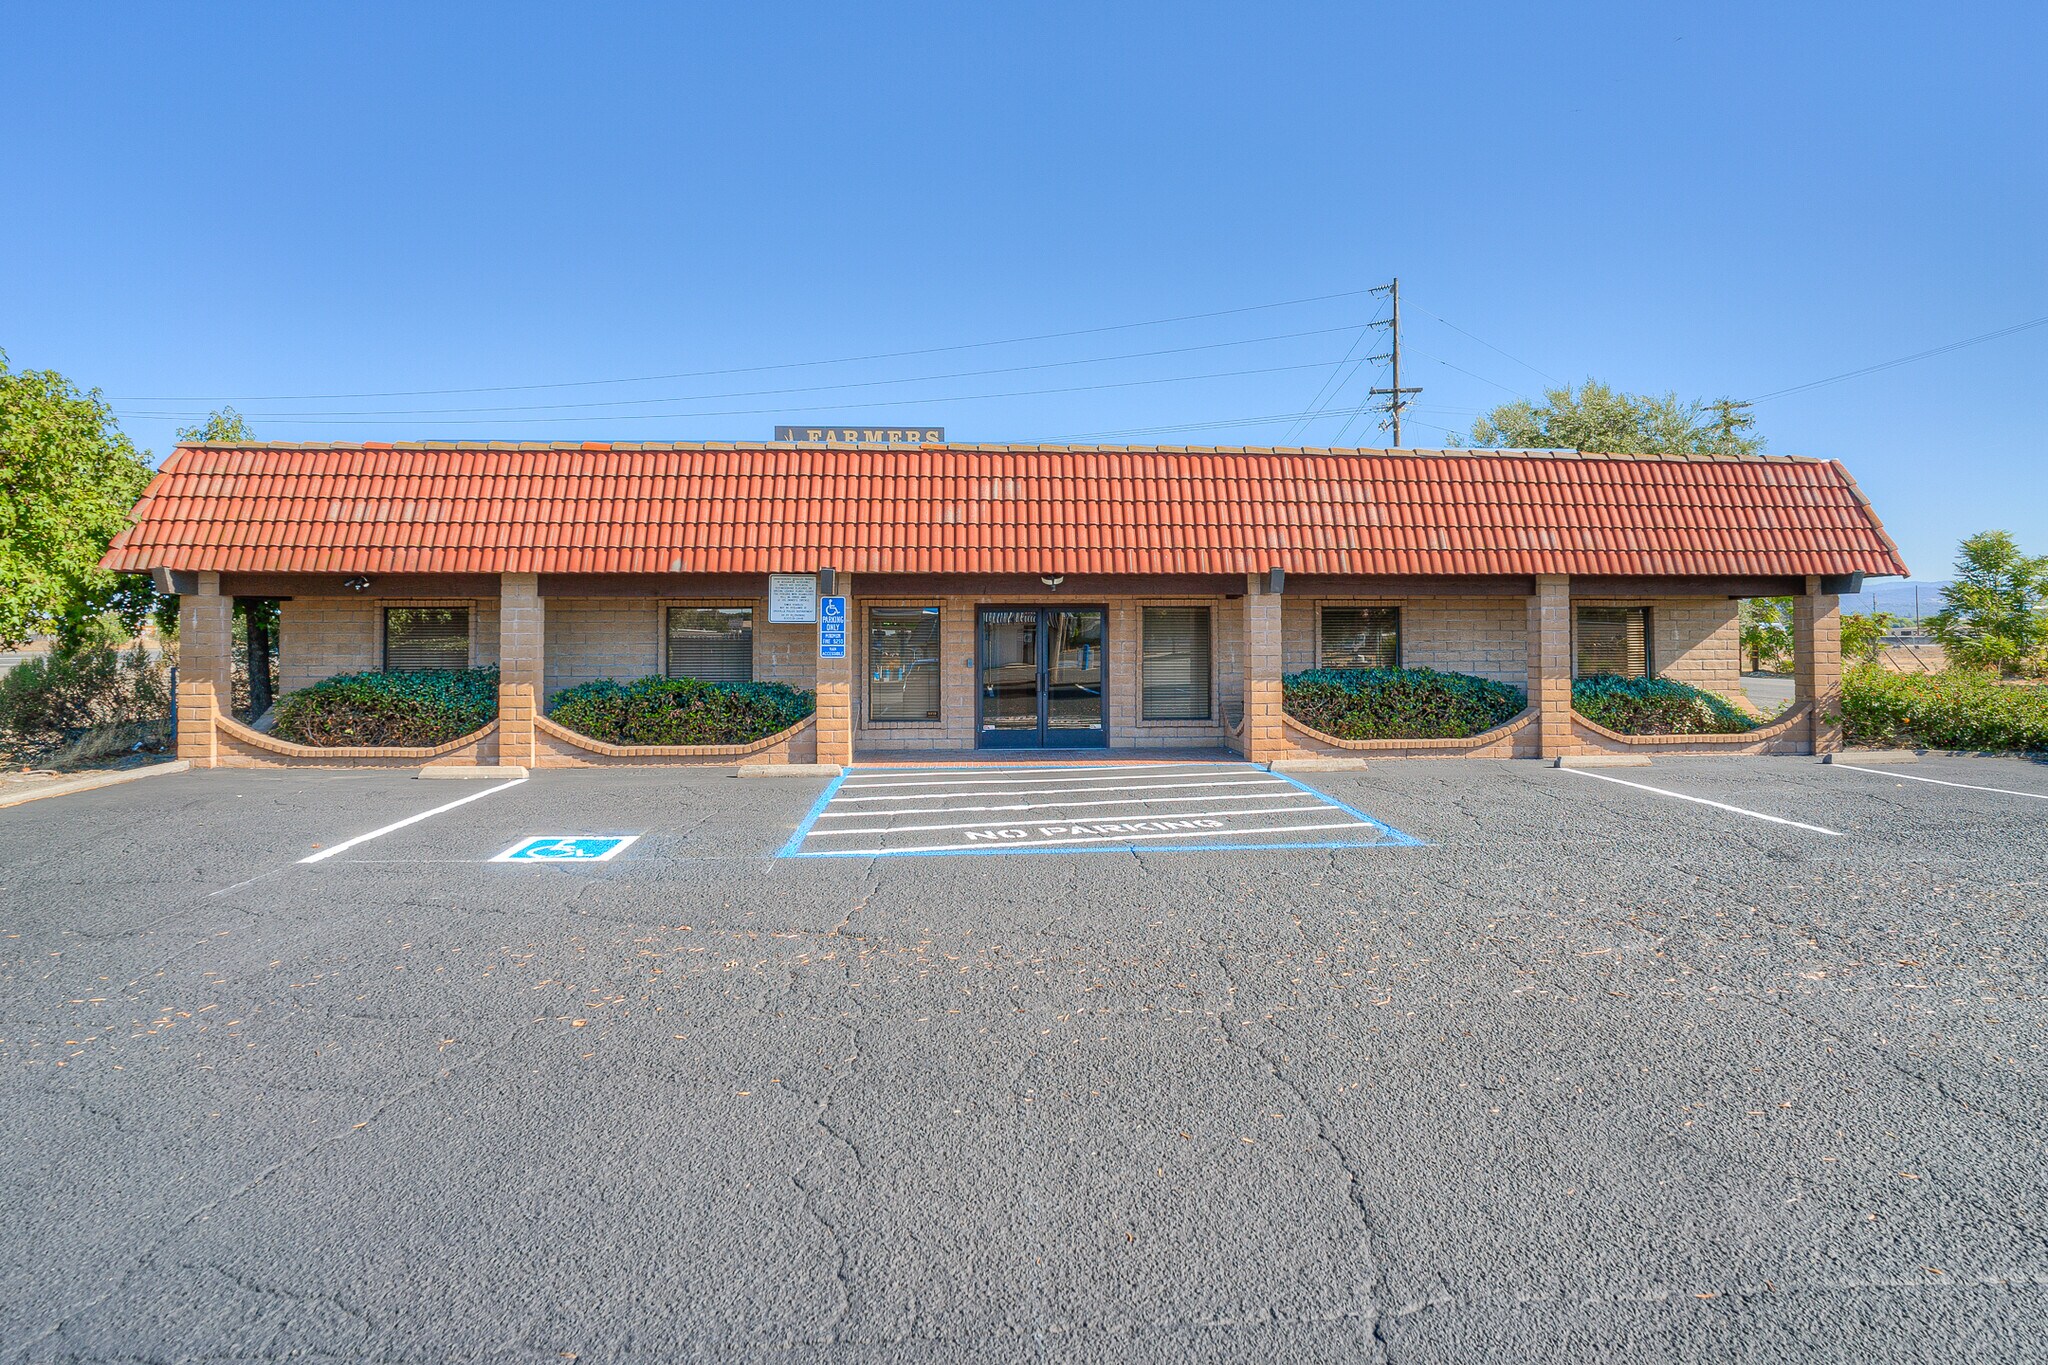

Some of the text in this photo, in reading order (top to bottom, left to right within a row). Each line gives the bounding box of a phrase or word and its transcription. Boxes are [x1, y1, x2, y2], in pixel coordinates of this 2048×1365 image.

[807, 429, 940, 442] FARMERS
[822, 616, 844, 624] PARKING
[826, 623, 840, 631] ONLY
[964, 819, 1225, 841] NO PARKING
